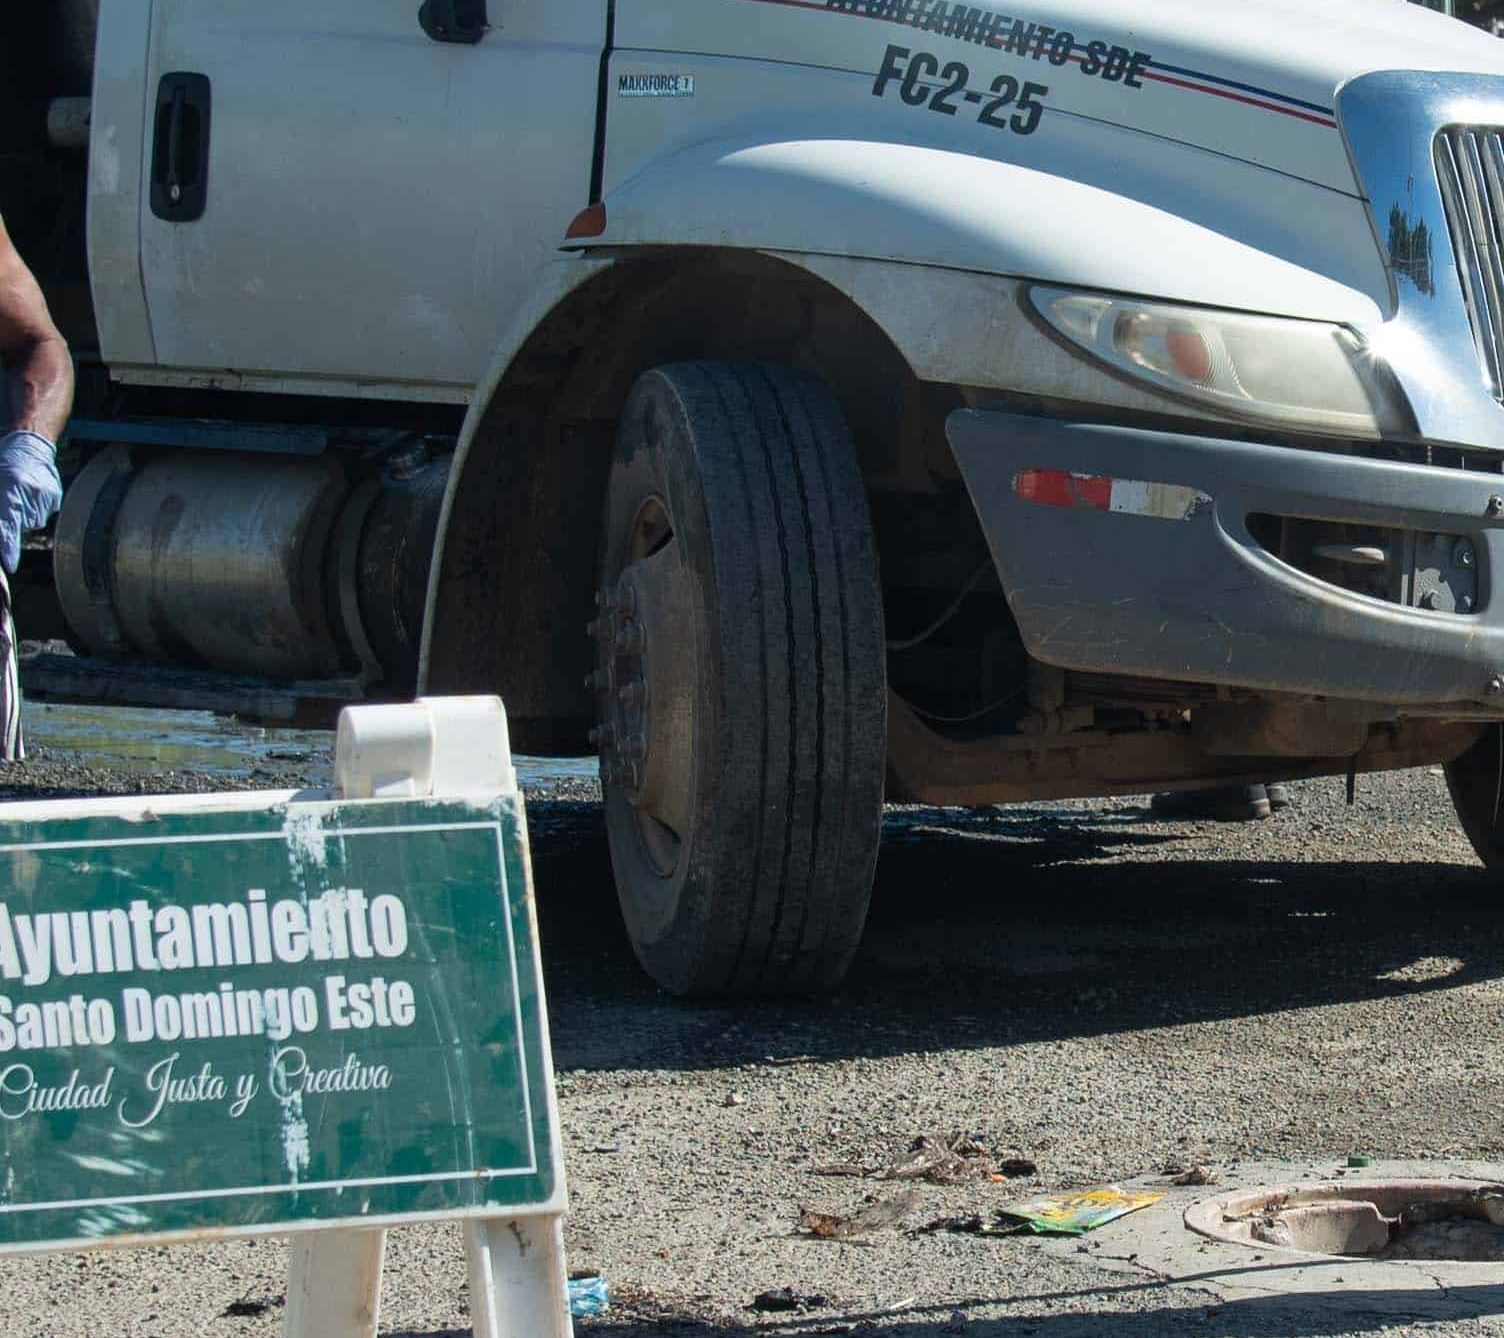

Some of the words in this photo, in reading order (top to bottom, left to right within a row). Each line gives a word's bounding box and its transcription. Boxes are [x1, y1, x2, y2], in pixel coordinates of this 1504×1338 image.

[871, 43, 1049, 136] FC2-25
[1080, 39, 1152, 89] SDE
[122, 981, 319, 1043] Domingo
[325, 974, 417, 1031] Este
[118, 1052, 230, 1128] Justa
[231, 1073, 260, 1119] y
[268, 1045, 393, 1102] Creativa
